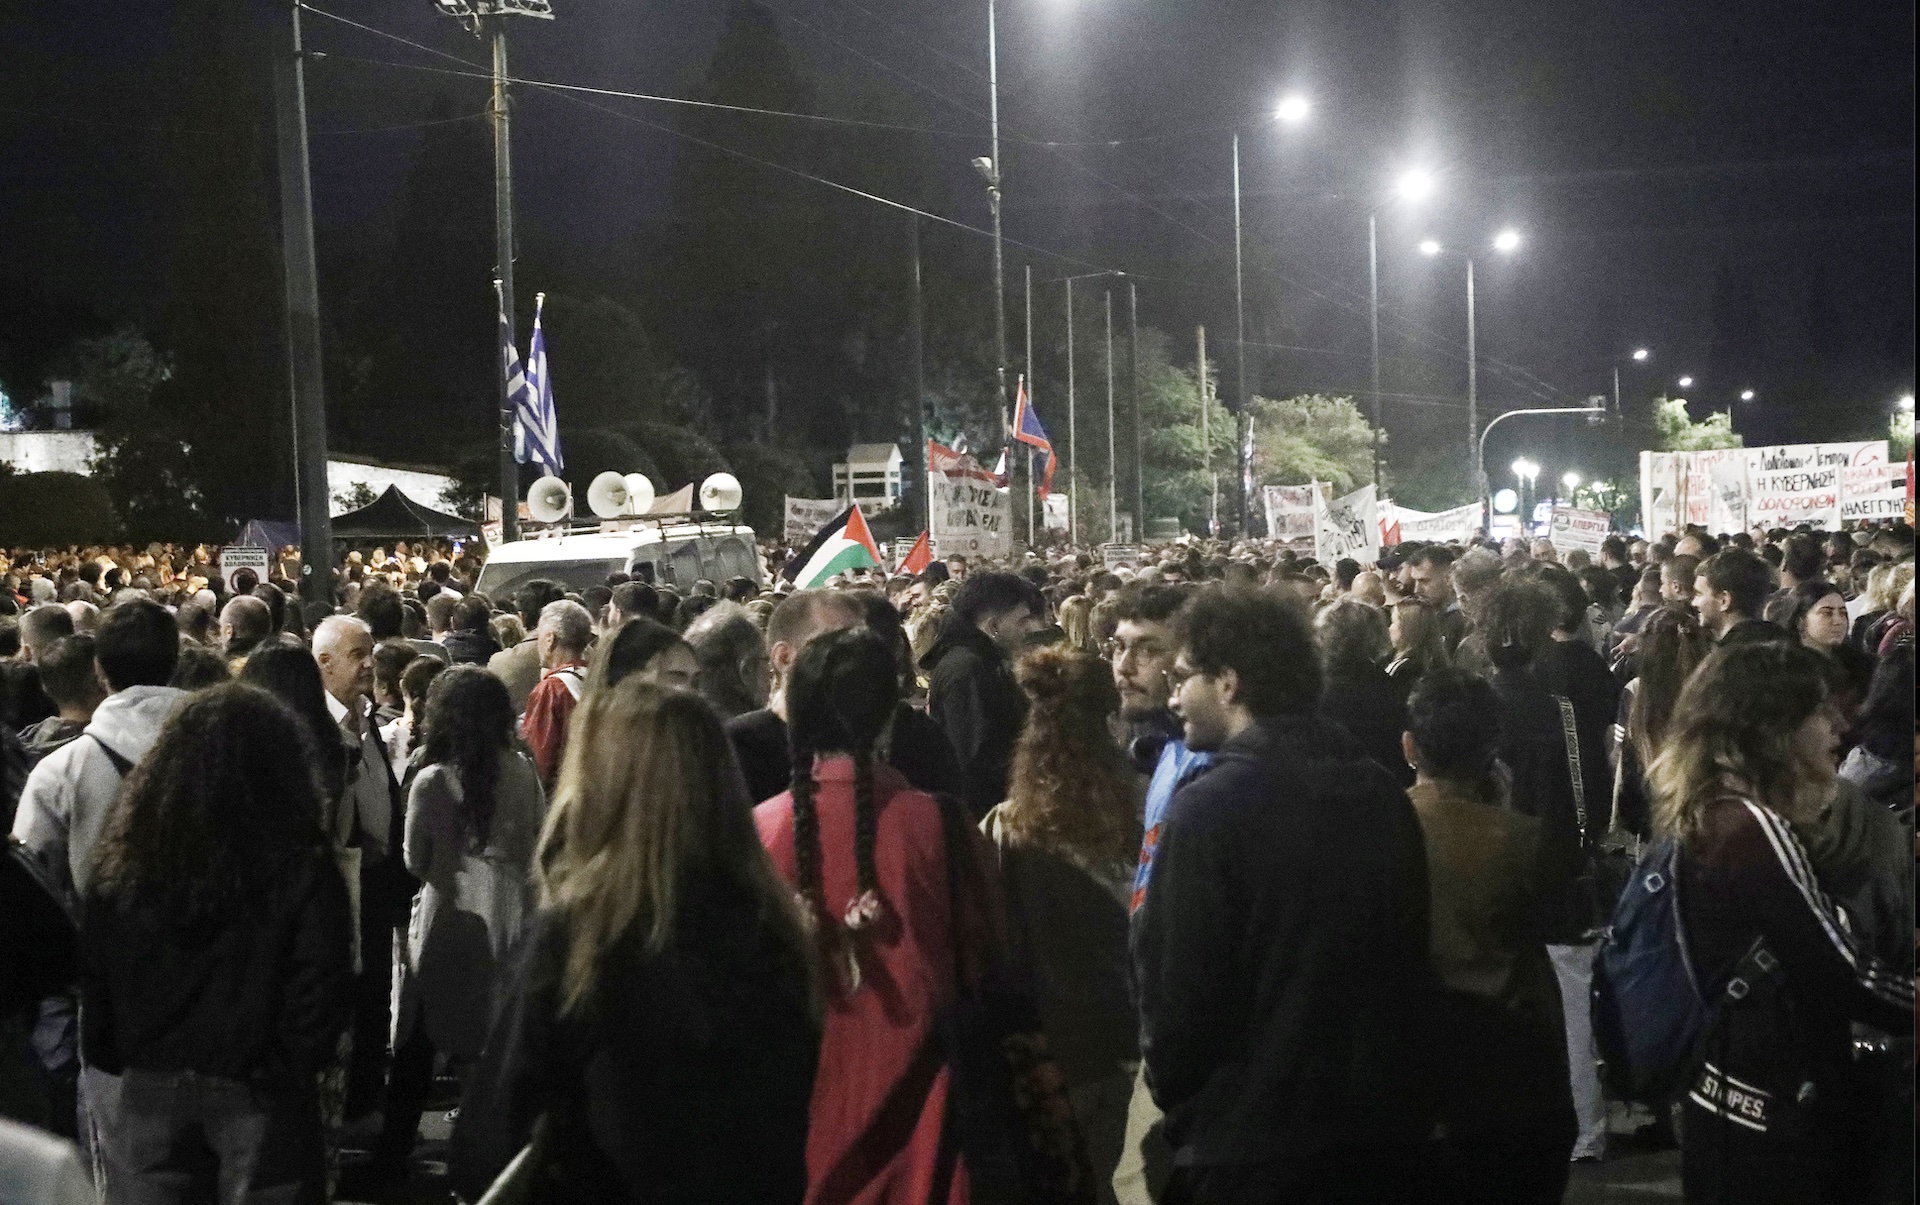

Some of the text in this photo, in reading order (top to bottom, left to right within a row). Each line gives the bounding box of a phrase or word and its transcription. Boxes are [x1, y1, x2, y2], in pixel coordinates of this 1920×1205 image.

[1758, 477, 1766, 490] Η
[1771, 469, 1836, 492] ΚΥΒΕΡΝΗΣΗ
[1758, 494, 1836, 511] ΔΟΛΟΦΟΝΩΝ
